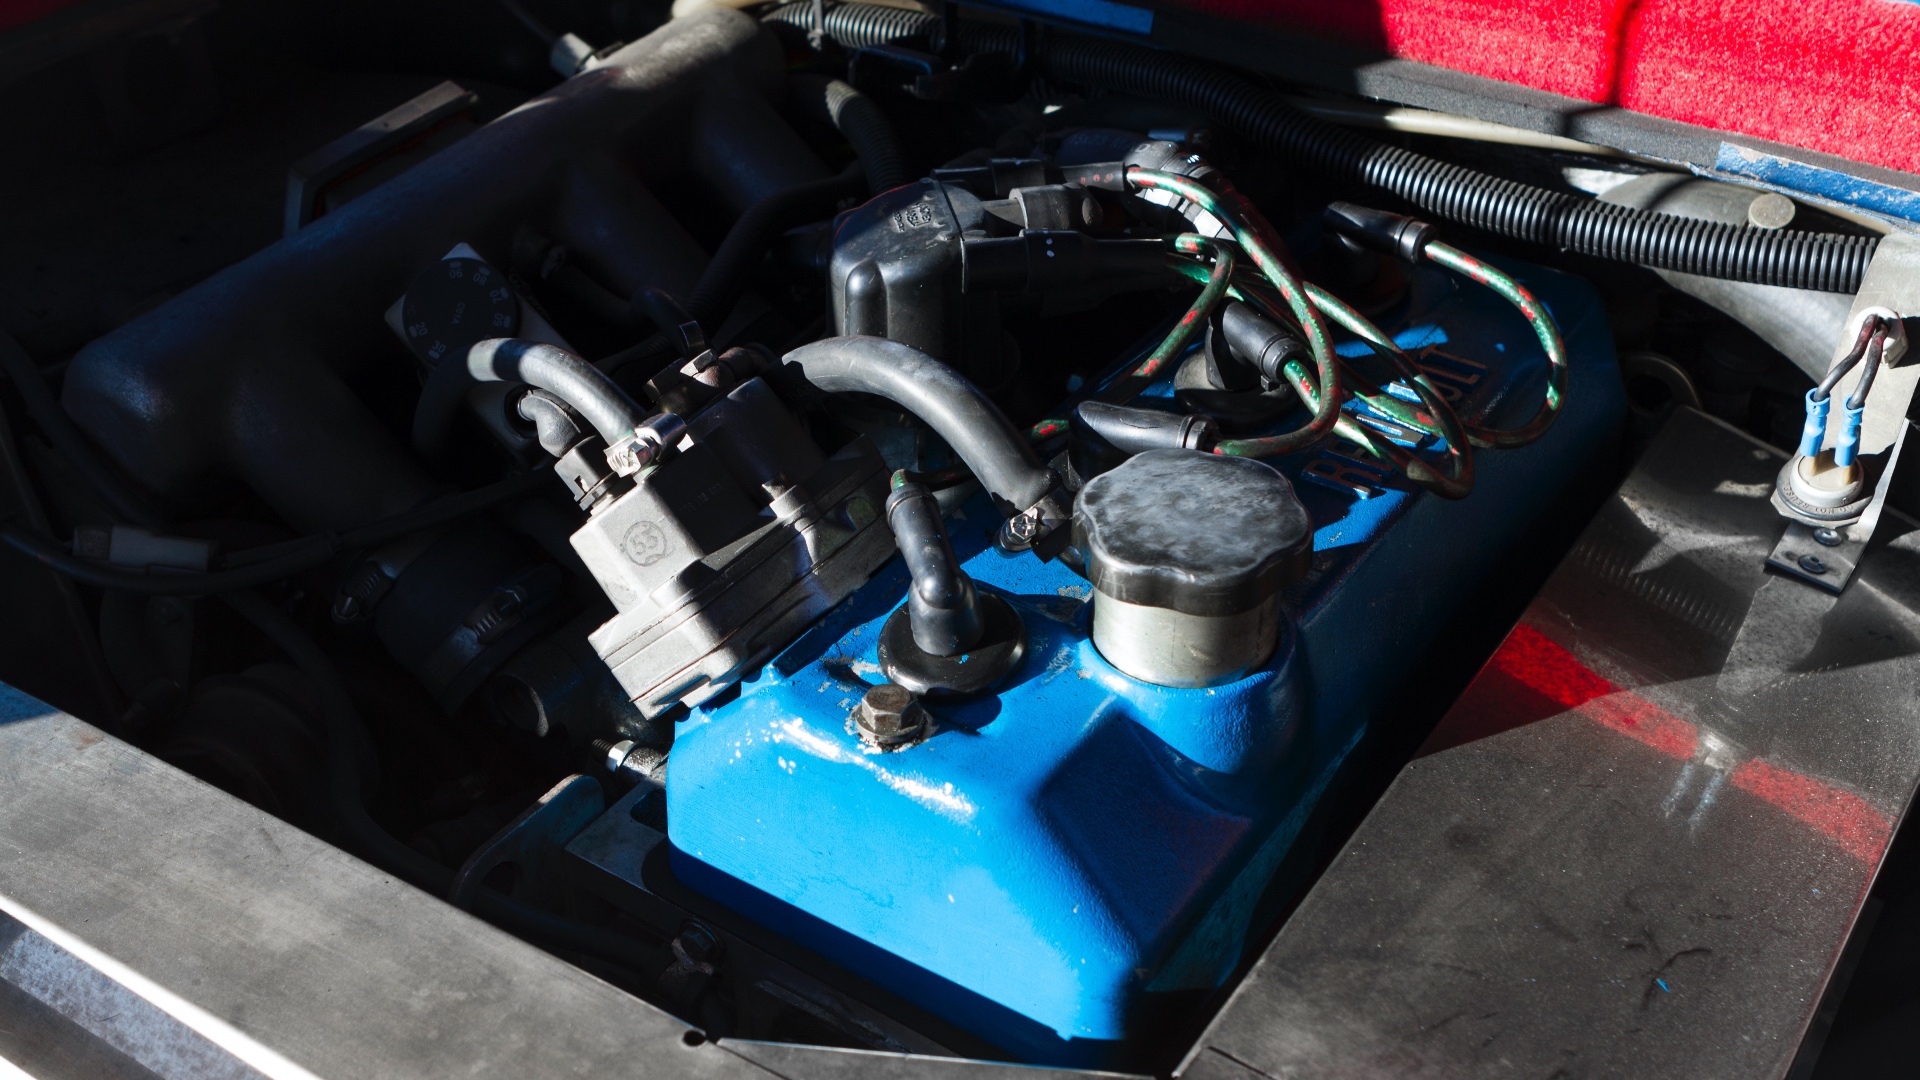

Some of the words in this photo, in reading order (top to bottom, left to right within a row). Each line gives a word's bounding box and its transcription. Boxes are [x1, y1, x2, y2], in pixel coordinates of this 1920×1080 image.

[472, 272, 487, 286] 80
[489, 289, 503, 305] 70
[492, 313, 504, 327] 60
[415, 321, 428, 336] 20
[431, 340, 447, 354] 30
[1301, 343, 1488, 499] RENULT
